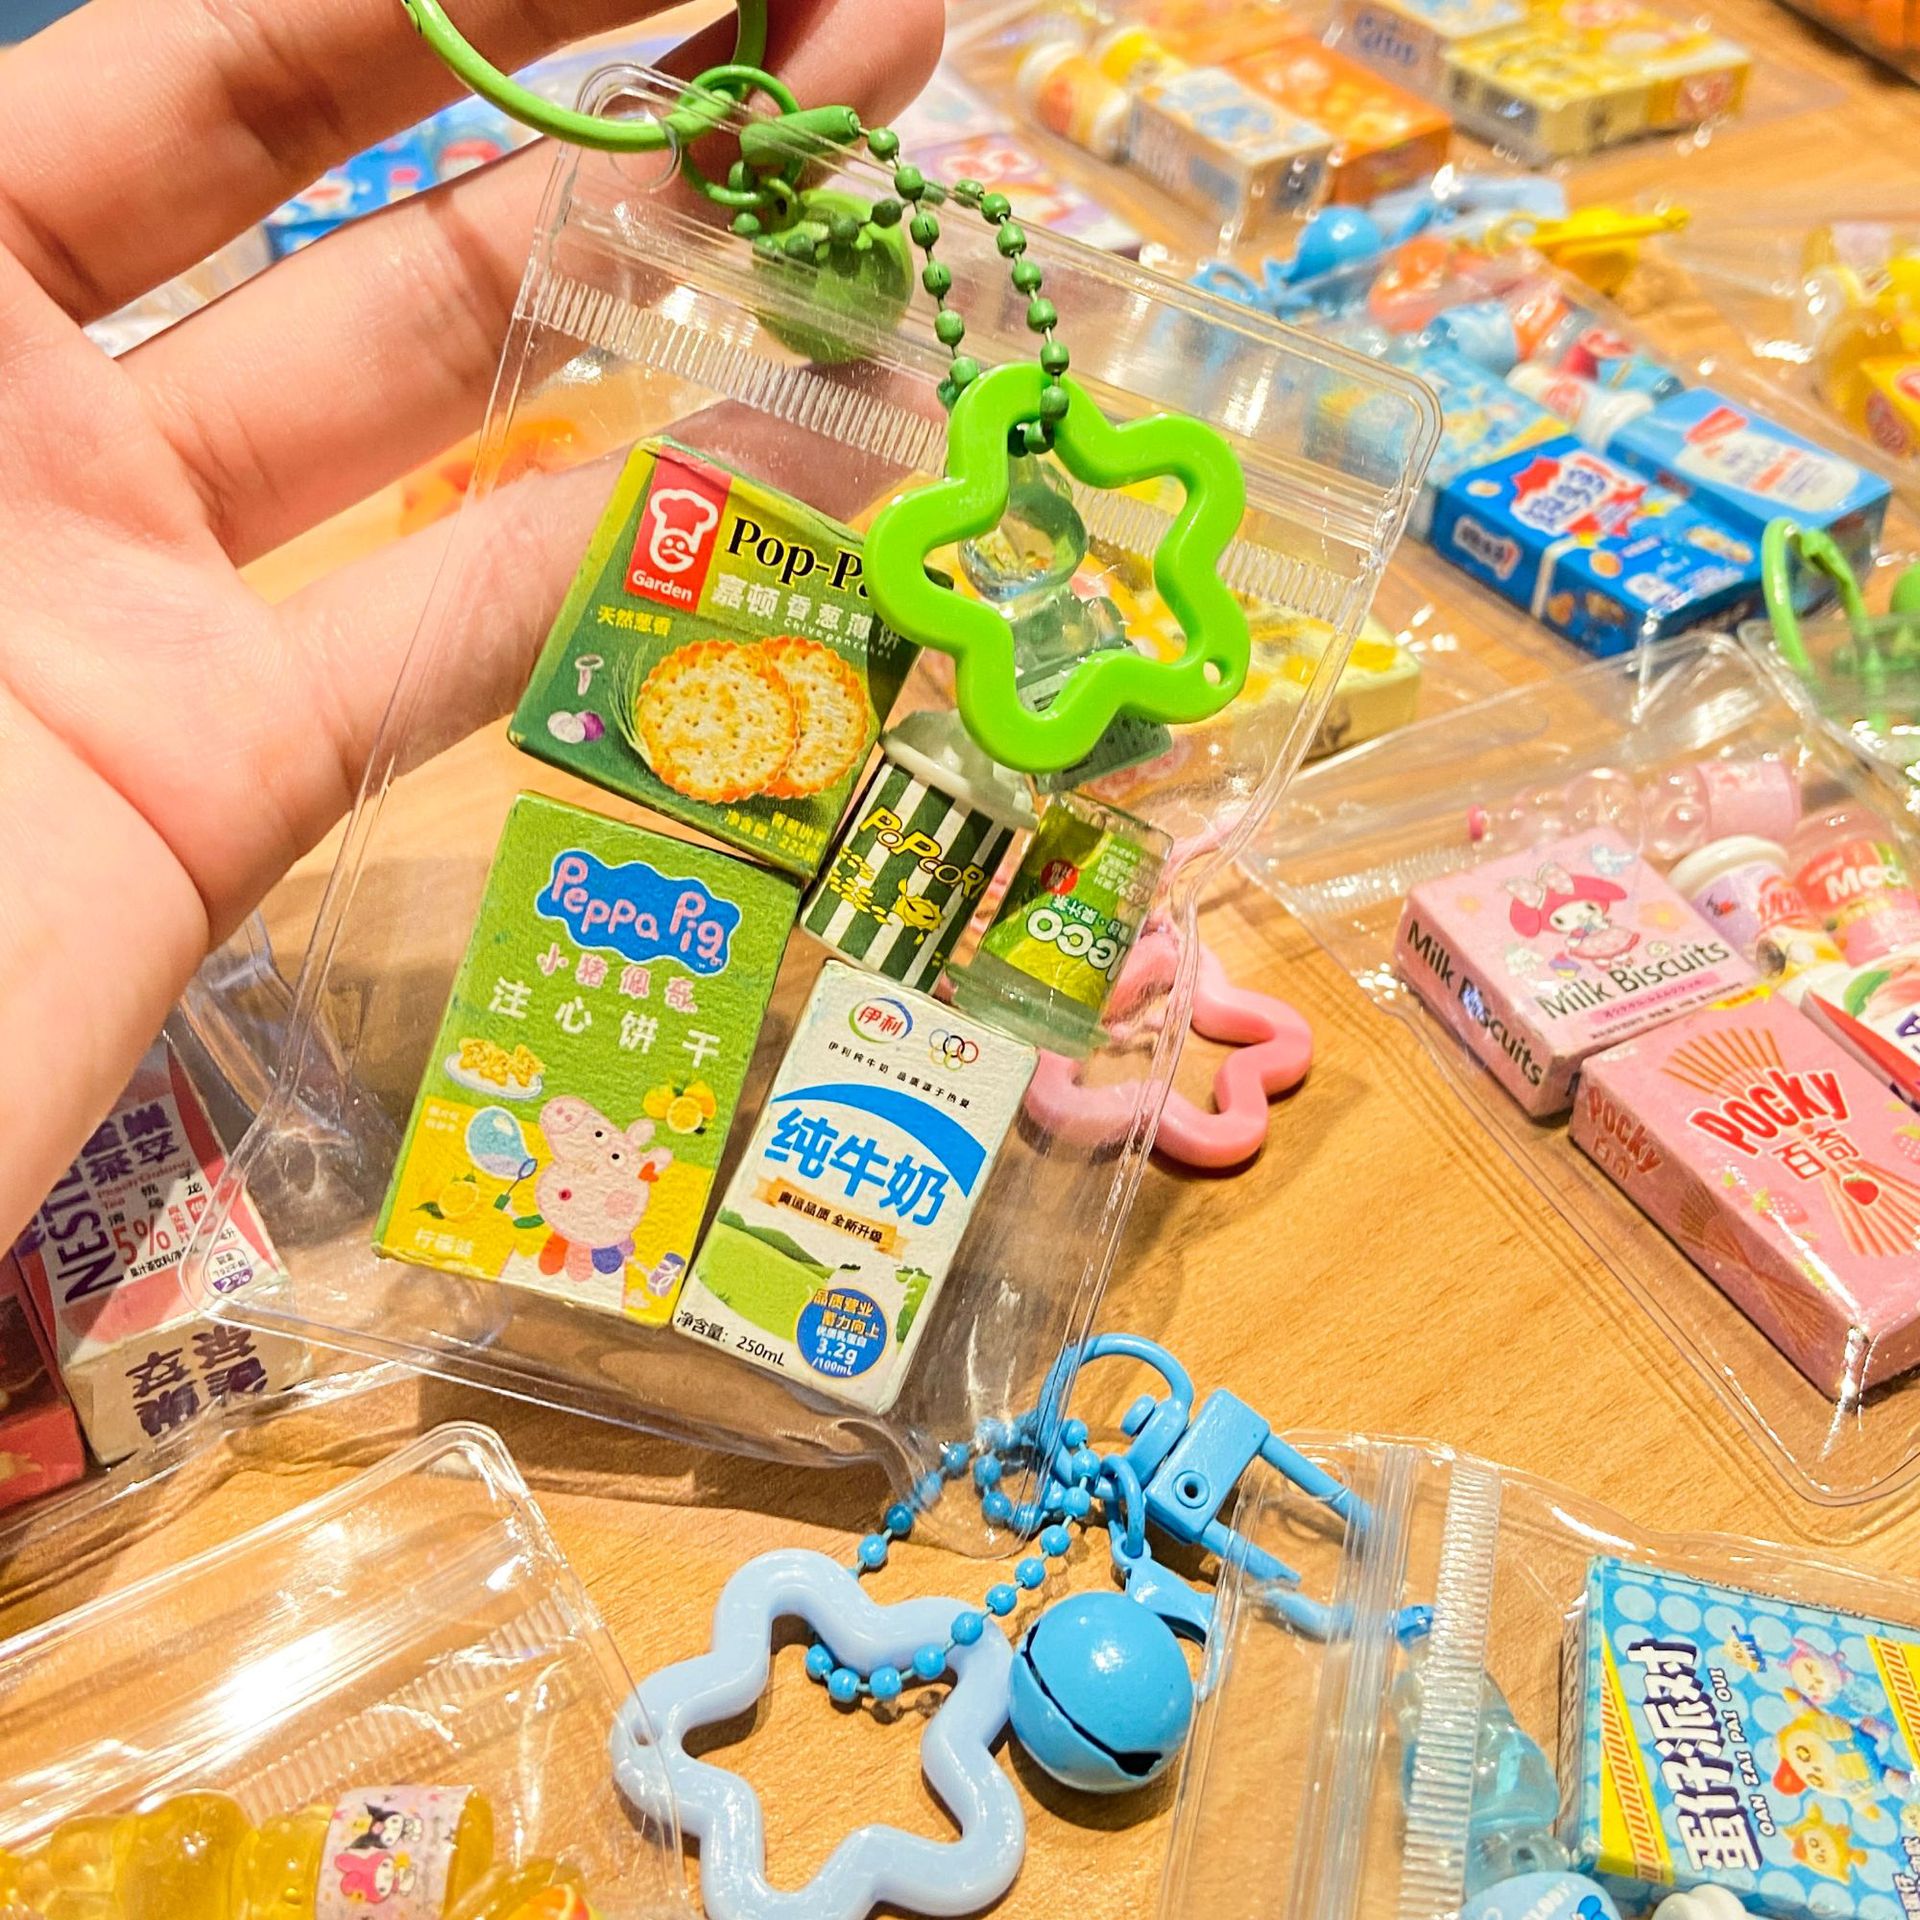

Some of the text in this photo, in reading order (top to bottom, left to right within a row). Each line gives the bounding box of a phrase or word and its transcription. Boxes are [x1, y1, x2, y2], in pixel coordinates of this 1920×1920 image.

[631, 570, 693, 602] Garden
[551, 856, 725, 960] Peppa Pig
[537, 943, 698, 1014] 小猪佩奇
[1408, 920, 1455, 989] Milk
[1536, 979, 1611, 1020] Milk
[1609, 942, 1730, 994] Biscuits
[488, 977, 720, 1068] 注心饼干
[857, 1004, 905, 1037] 伊利
[764, 1107, 950, 1227] 纯牛奶
[1772, 1125, 1860, 1181] 百奇
[114, 1211, 171, 1263] 5%
[831, 1213, 883, 1244] 全新升级
[736, 1335, 786, 1368] 250mL
[812, 1357, 853, 1375] /100mL
[816, 1338, 858, 1365] 3.2g
[1721, 1709, 1746, 1744] PAI
[1628, 1638, 1762, 1871] 蛋仔派对
[1736, 1750, 1761, 1786] ZAI
